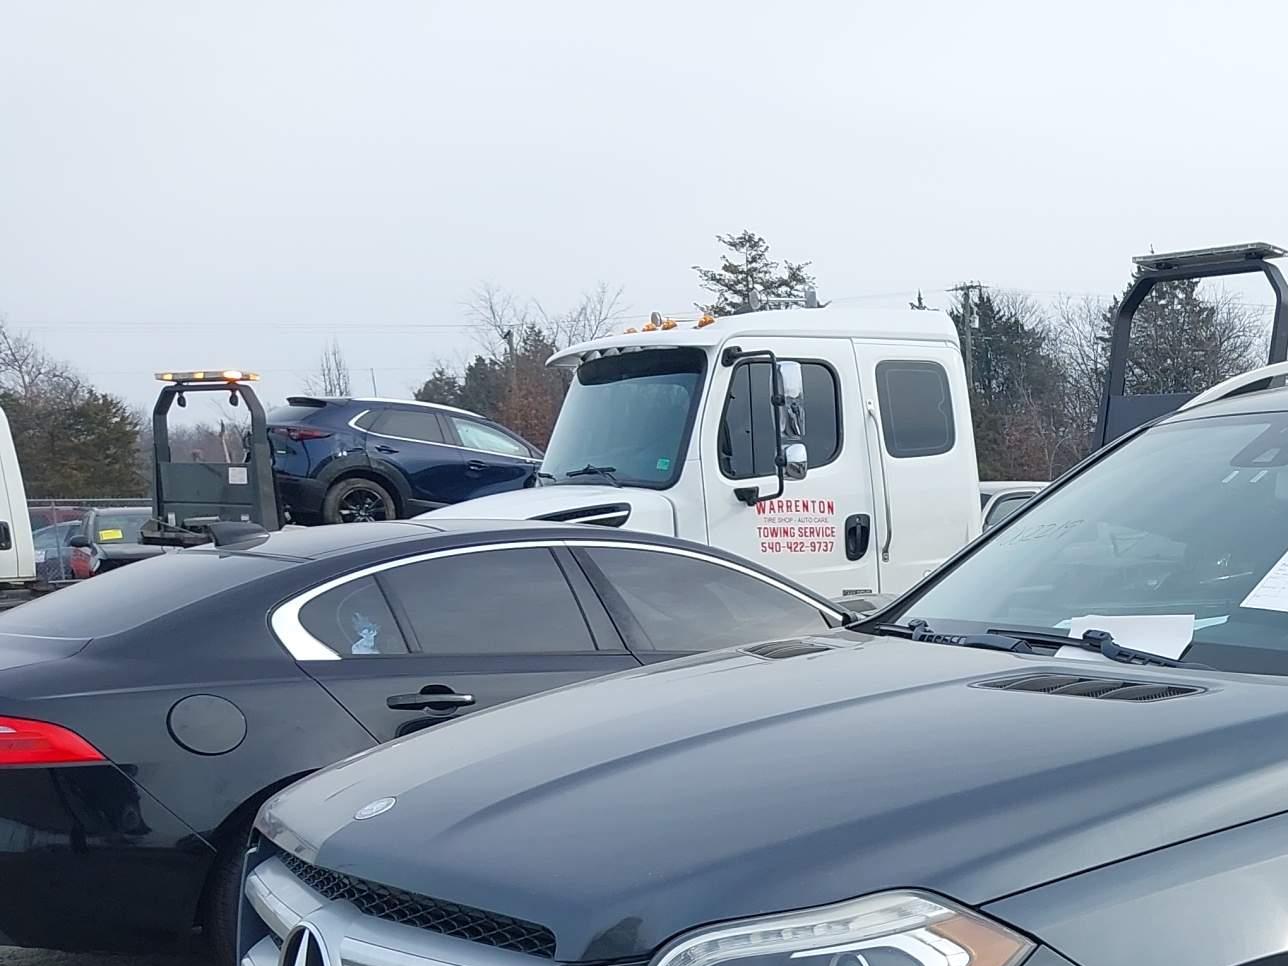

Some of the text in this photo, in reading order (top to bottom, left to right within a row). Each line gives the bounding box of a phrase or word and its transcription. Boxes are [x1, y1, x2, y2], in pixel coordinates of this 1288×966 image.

[756, 500, 834, 515] WARRENTON
[757, 527, 836, 538] TOWING SERVICE
[761, 541, 834, 553] 540-422-9737
